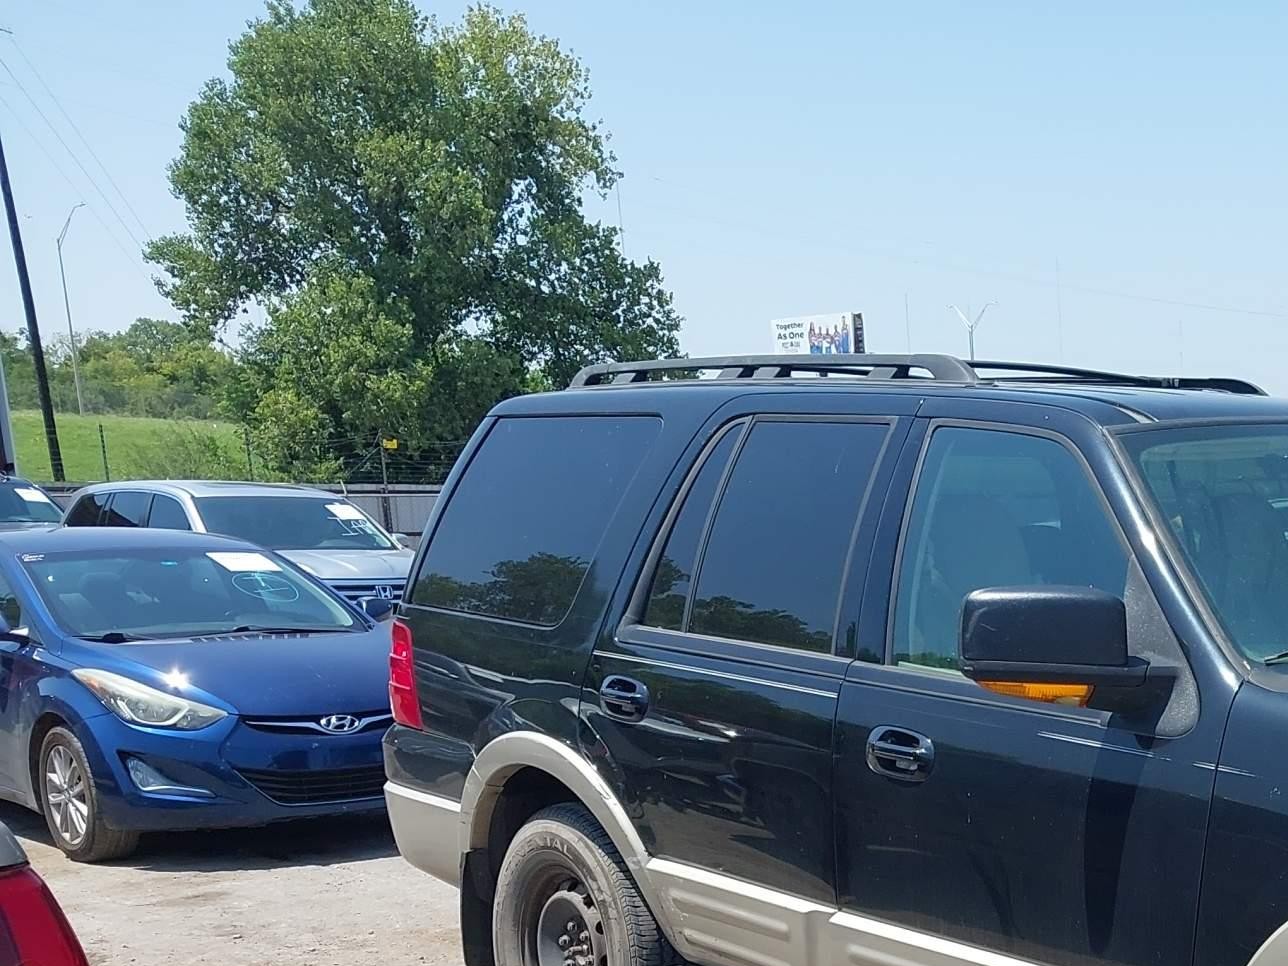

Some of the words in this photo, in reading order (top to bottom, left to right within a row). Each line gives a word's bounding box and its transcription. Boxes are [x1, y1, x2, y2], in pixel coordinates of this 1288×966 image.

[776, 322, 803, 331] Together
[777, 332, 787, 340] As
[788, 331, 804, 339] One
